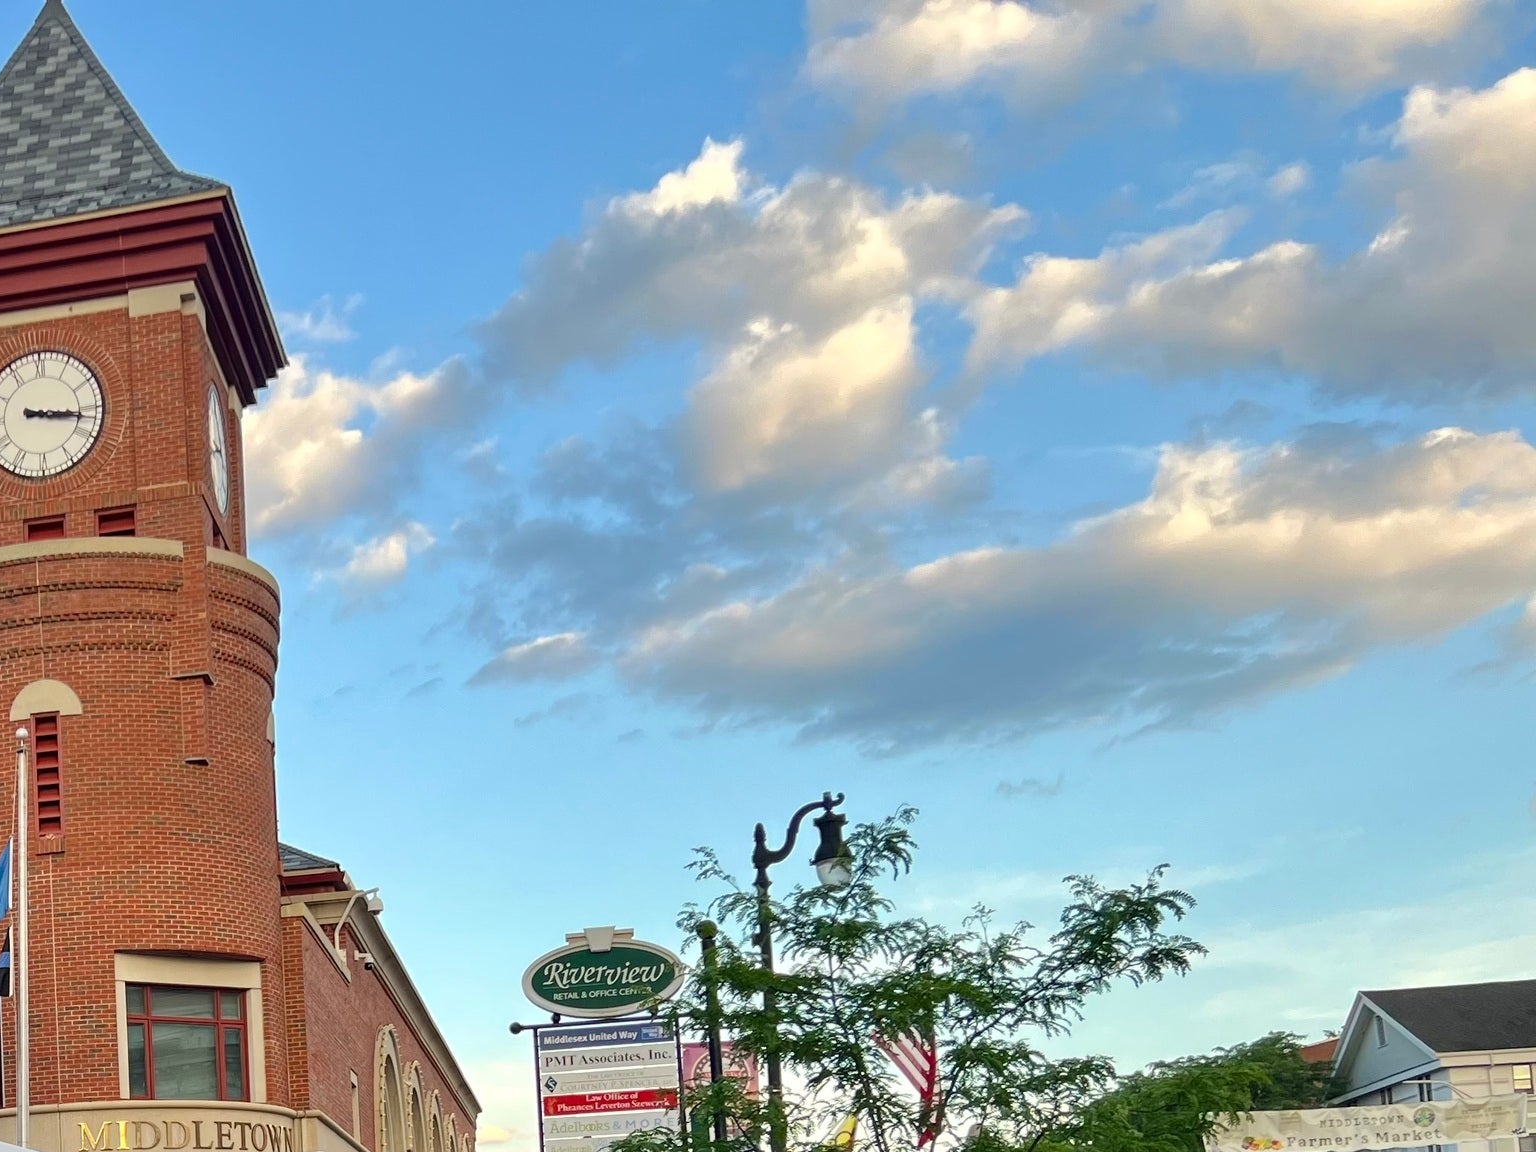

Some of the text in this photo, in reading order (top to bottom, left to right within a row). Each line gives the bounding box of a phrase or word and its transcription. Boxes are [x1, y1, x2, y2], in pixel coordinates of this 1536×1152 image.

[542, 960, 665, 988] Riverview
[553, 992, 580, 1000] RETAIL
[589, 988, 618, 998] OFFICE
[544, 1030, 638, 1045] Middlesex United Way
[545, 1055, 576, 1068] PMT
[649, 1049, 673, 1060] Inc.
[586, 1091, 639, 1102] Law Office of
[612, 1122, 621, 1130] &
[625, 1116, 675, 1130] MORE
[1319, 1114, 1405, 1129] MIDDLETOWN
[1286, 1128, 1443, 1148] Farmer's Market
